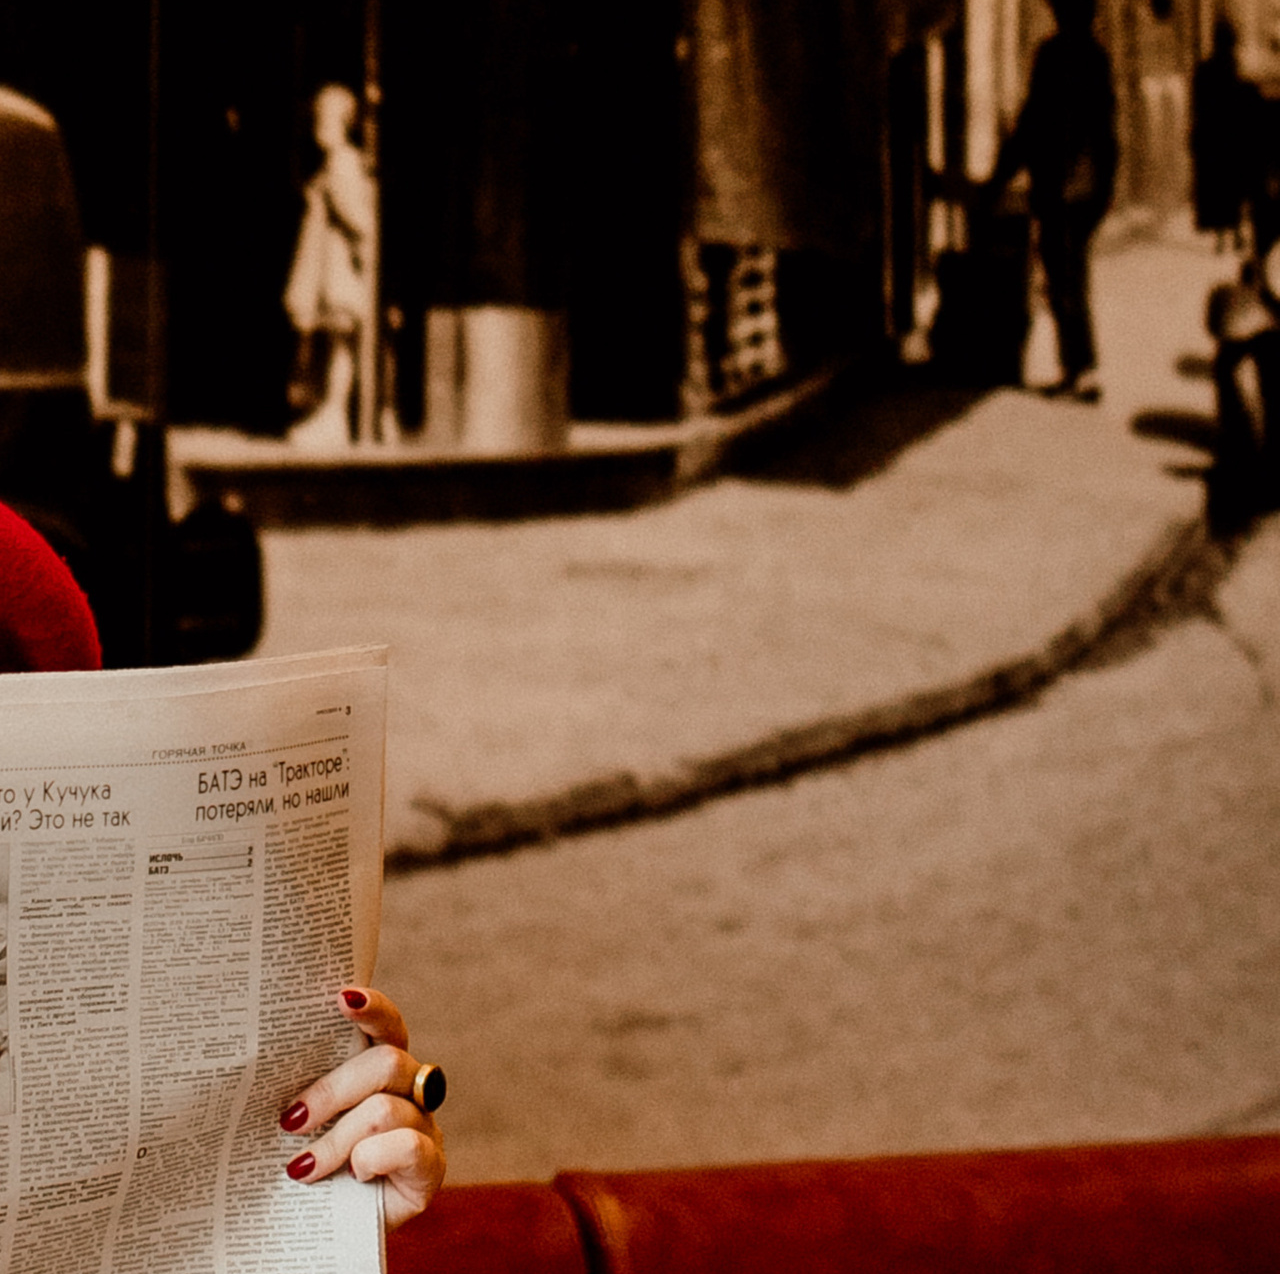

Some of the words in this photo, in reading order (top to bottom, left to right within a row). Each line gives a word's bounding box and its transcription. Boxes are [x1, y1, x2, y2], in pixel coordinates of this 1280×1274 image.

[343, 705, 352, 716] 3
[152, 746, 206, 760] ГОРЯЧАЯ
[212, 741, 247, 755] ТОЧКА
[197, 768, 243, 795] БАТЭ
[248, 770, 267, 788] на
[23, 786, 36, 808] у
[42, 780, 111, 807] Кучука
[195, 797, 277, 823] потеряли,
[282, 792, 301, 811] но
[305, 782, 350, 804] нашли
[29, 808, 65, 830] Это
[72, 811, 95, 828] не
[102, 810, 131, 828] так
[148, 865, 169, 875] БАТЭ
